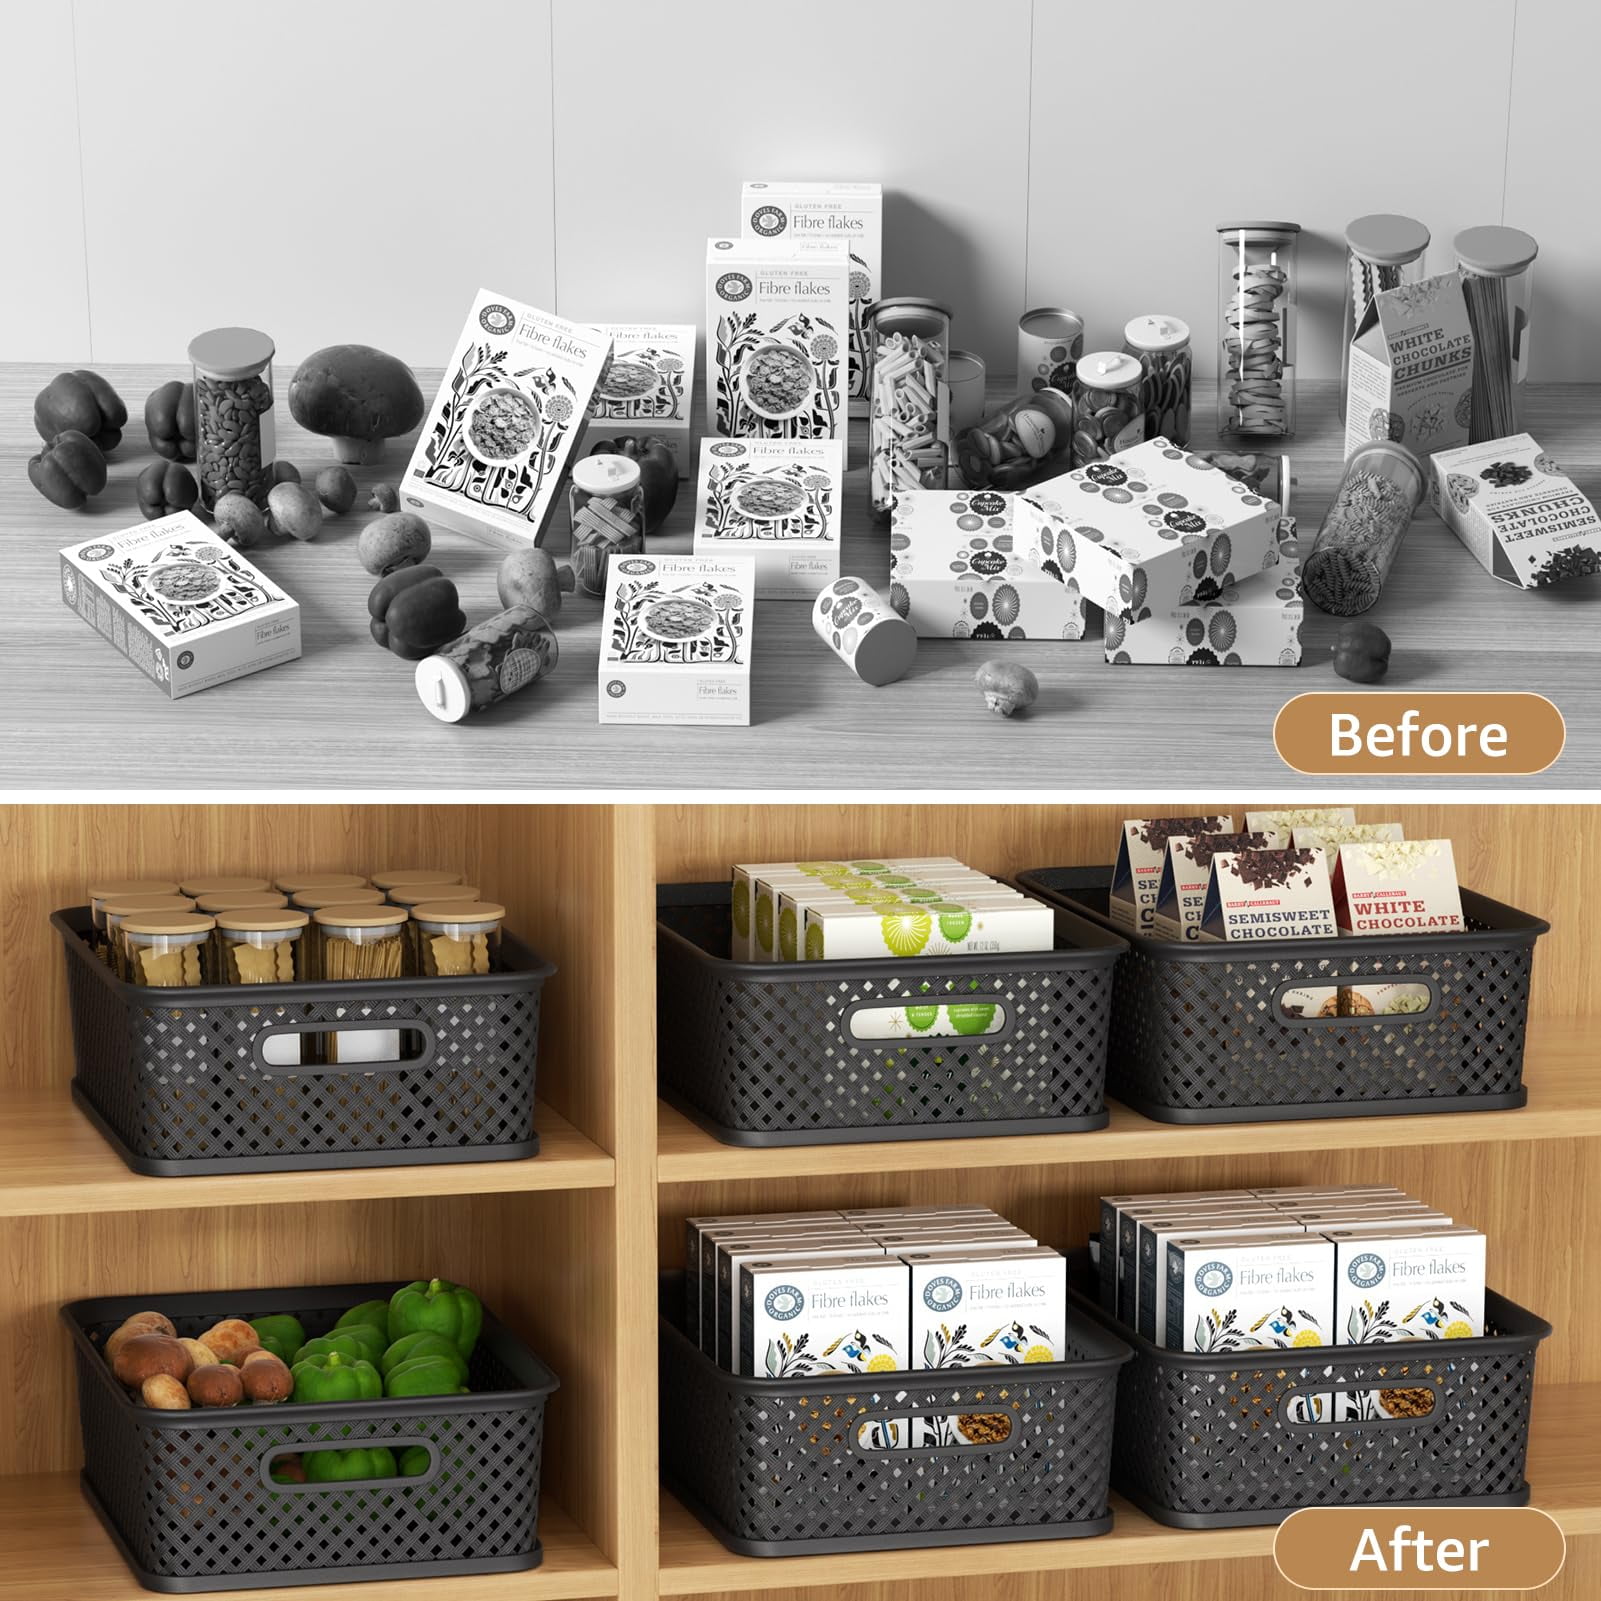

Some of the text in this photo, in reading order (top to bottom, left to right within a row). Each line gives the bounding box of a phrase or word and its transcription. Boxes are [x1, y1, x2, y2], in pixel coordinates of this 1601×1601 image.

[793, 214, 864, 229] Fibre flakes
[759, 280, 830, 295] Fibre flakes
[519, 323, 550, 344] Fibre
[552, 335, 588, 360] flakes
[1390, 328, 1444, 353] WHITE
[1393, 334, 1471, 366] CHOCOLATE
[1394, 346, 1472, 380] CHUNKS
[788, 446, 824, 454] flakes
[1490, 496, 1584, 524] CHUNKS
[1498, 506, 1590, 533] CHOCOLATE
[1505, 516, 1596, 543] SEMISWEET
[662, 564, 696, 572] Fibre
[699, 564, 736, 572] flakes
[1354, 900, 1426, 915] WHITE
[1228, 910, 1330, 924] SEMISWEET
[1357, 915, 1460, 930] CHOCOLATE
[1231, 924, 1334, 939] CHOCOLATE
[1196, 1263, 1232, 1282] DOVES FARM
[1350, 1255, 1384, 1274] DOVES FARM
[1392, 1258, 1466, 1277] Fibre flakes
[1240, 1266, 1314, 1285] Fibre flakes
[1352, 1274, 1382, 1288] ORGANIC
[766, 1286, 802, 1306] DOVES FARM
[924, 1278, 960, 1296] DOVES FARM
[970, 1282, 1046, 1300] Fibre flakes
[1198, 1282, 1230, 1296] ORGANIC
[812, 1290, 888, 1309] Fibre flakes
[926, 1298, 959, 1310] ORGANIC
[768, 1306, 801, 1320] ORGANIC
